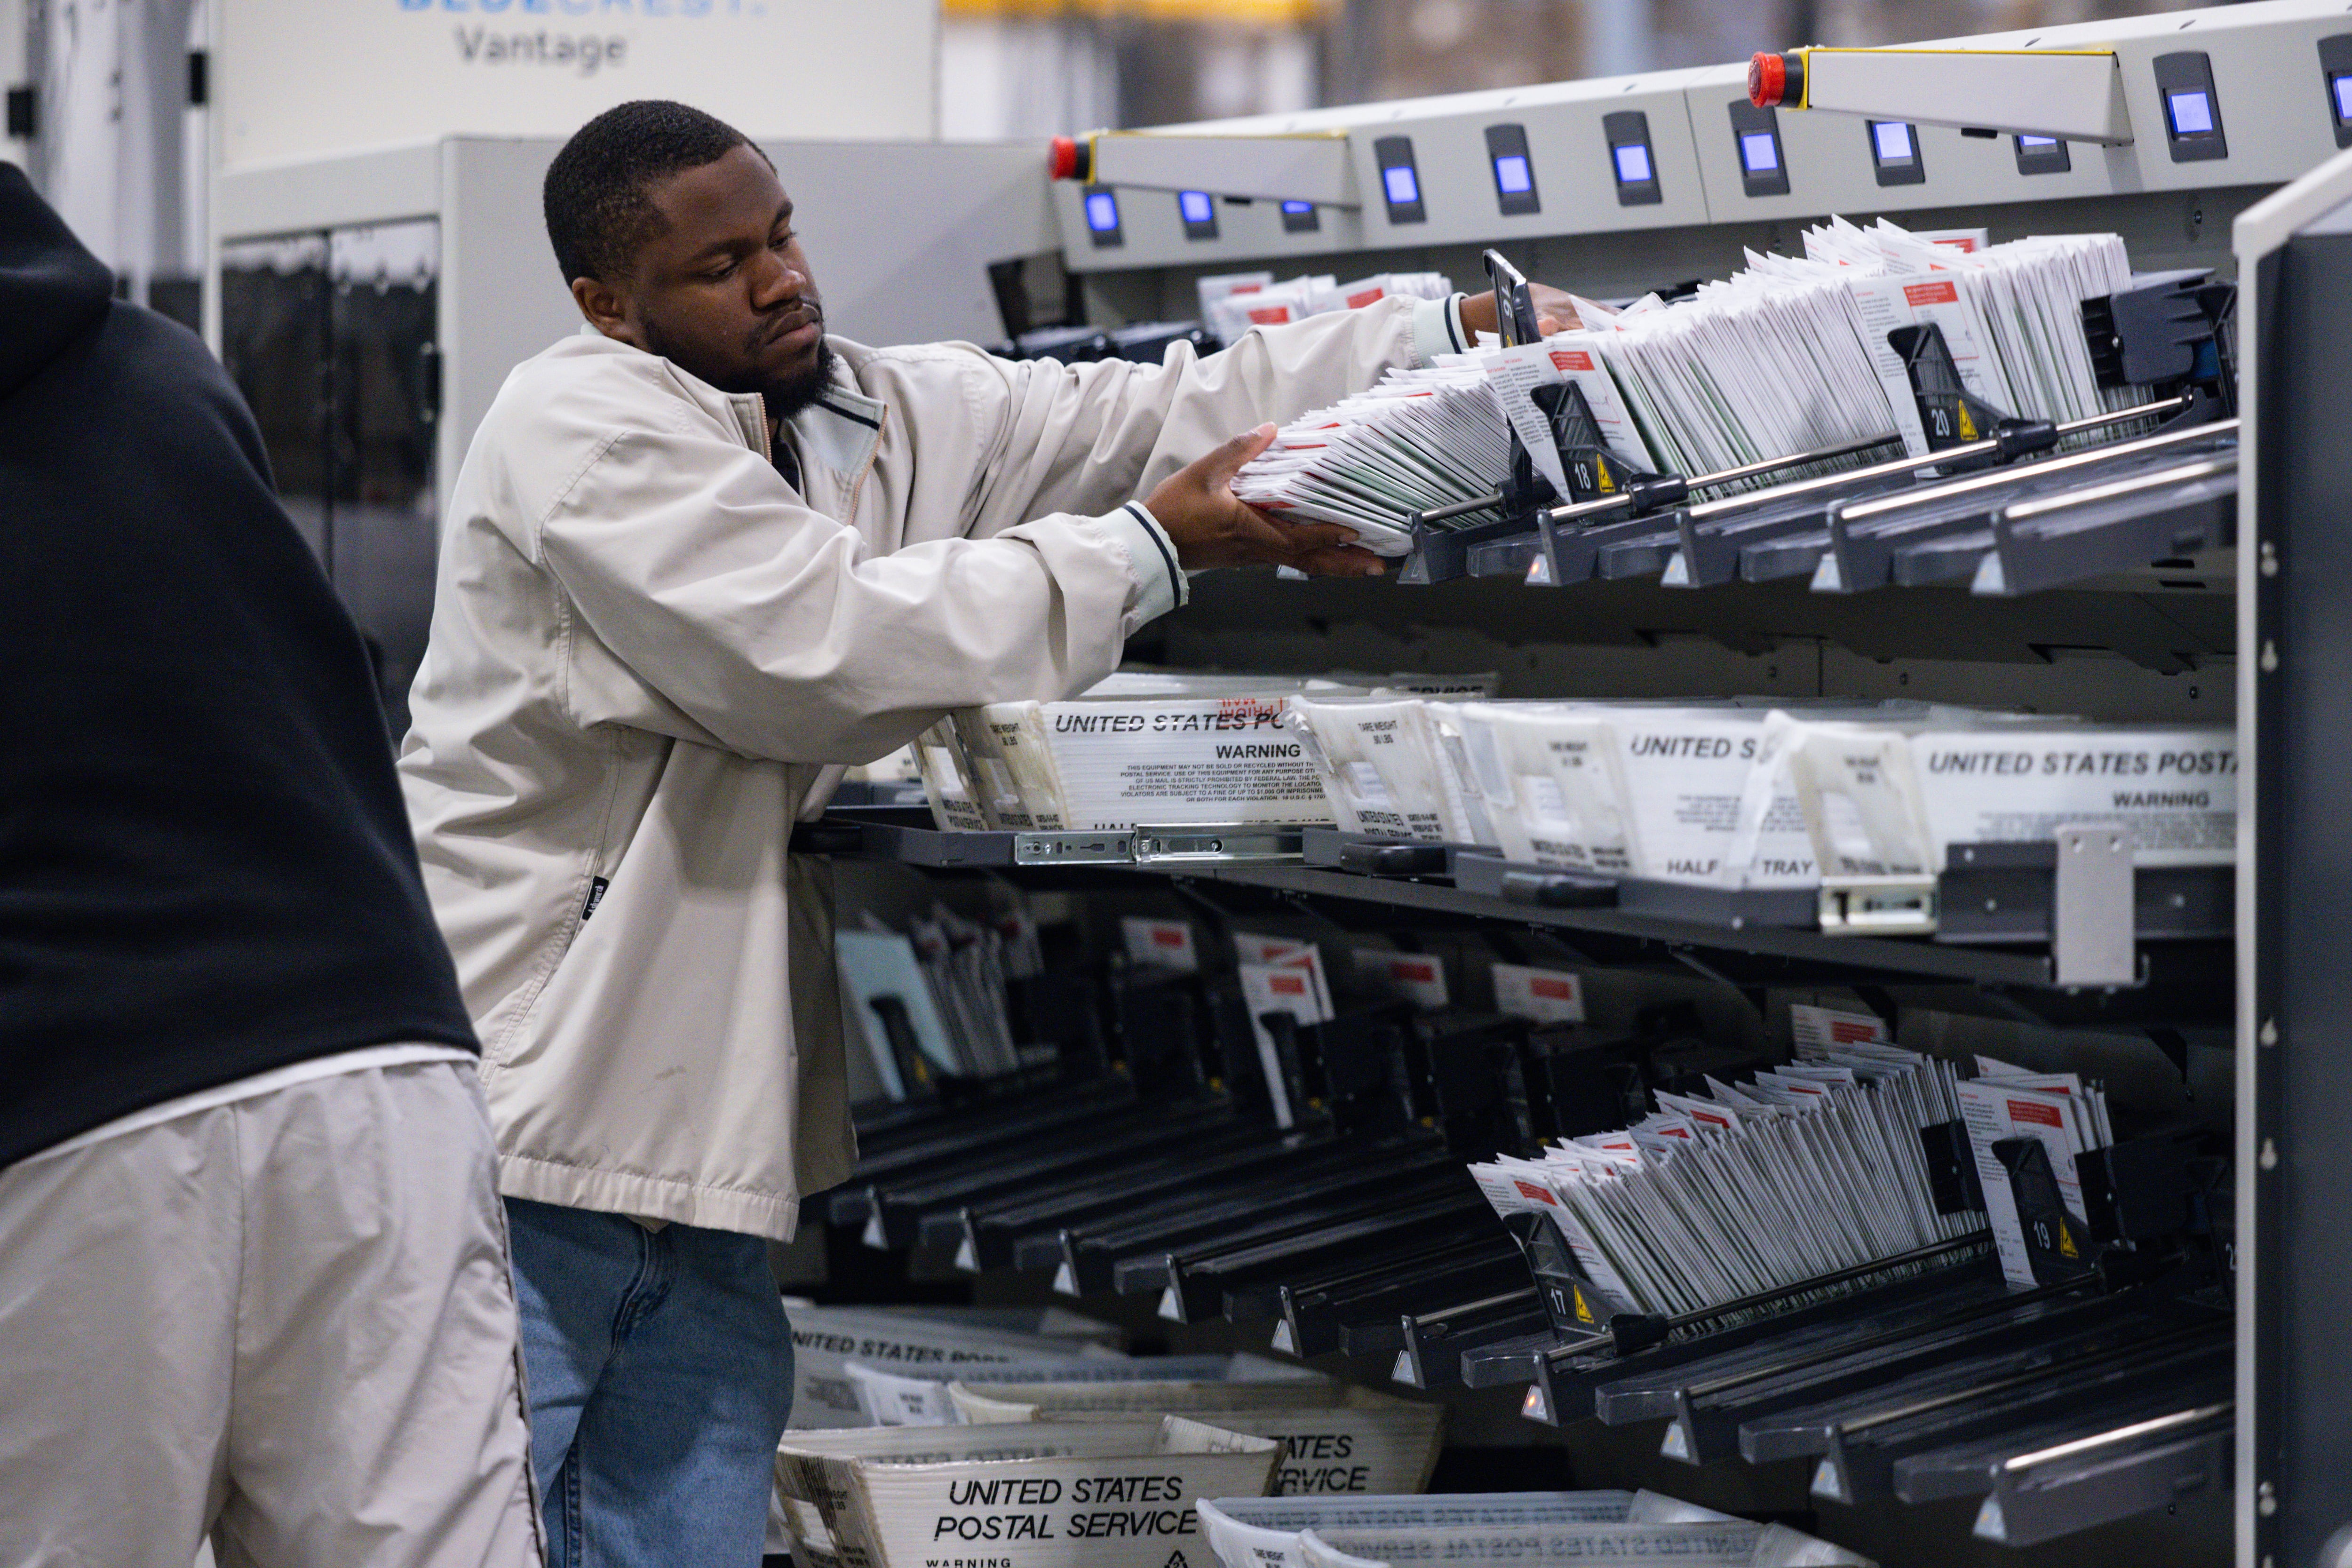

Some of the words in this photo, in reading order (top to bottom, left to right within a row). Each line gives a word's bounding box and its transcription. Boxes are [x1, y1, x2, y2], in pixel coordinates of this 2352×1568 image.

[453, 23, 628, 79] Vantage
[1931, 408, 1951, 438] 20
[1574, 462, 1591, 490] 18
[1056, 715, 1145, 732] UNITED
[1152, 713, 1247, 731] STATES
[1216, 743, 1301, 759] WARNING
[1630, 734, 1732, 759] UNITED
[1929, 752, 2033, 775] UNITED
[2042, 753, 2149, 775] STATES
[2113, 790, 2210, 809] WARNING
[1667, 858, 1719, 876] HALF
[1762, 859, 1814, 876] TRAY
[2033, 1220, 2051, 1250] 19
[1549, 1288, 1567, 1315] 17
[792, 1330, 856, 1354] NITED
[859, 1338, 946, 1362] STATES
[949, 1478, 1063, 1505] UNITED
[1071, 1476, 1183, 1503] STATES
[1279, 1466, 1371, 1493] RVICE
[933, 1514, 1055, 1541] POSTAL
[1066, 1509, 1198, 1538] SERVICE
[926, 1558, 1011, 1568] WARNING
